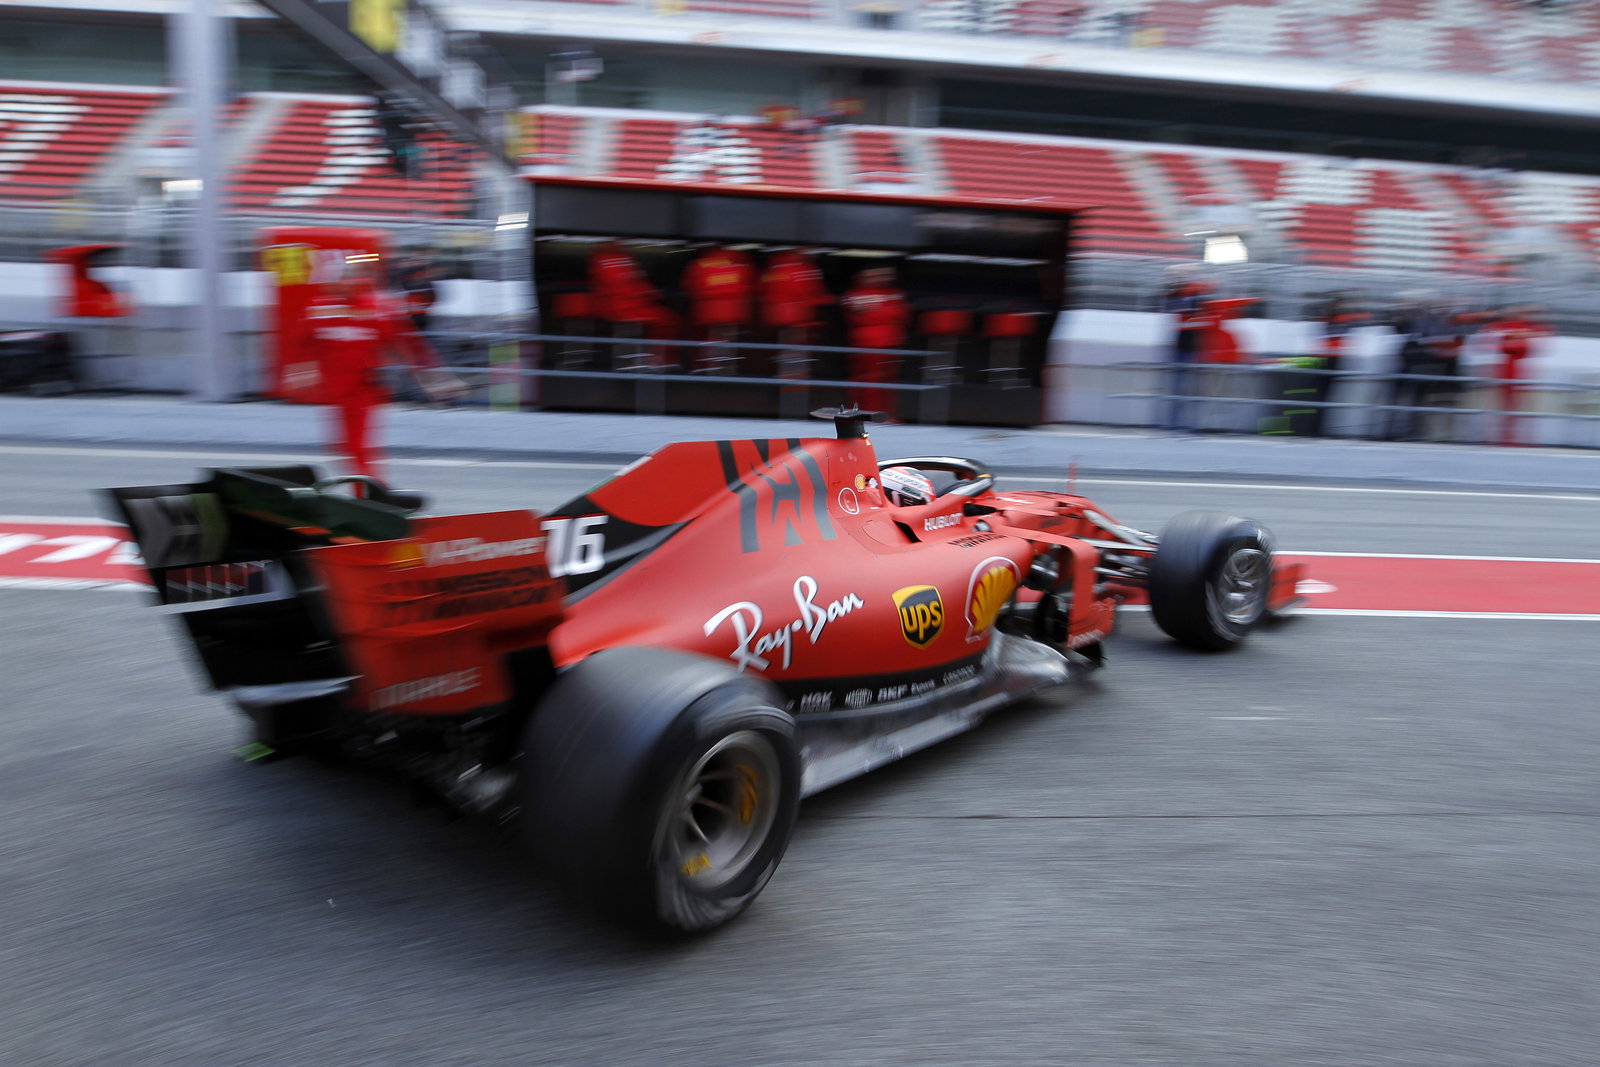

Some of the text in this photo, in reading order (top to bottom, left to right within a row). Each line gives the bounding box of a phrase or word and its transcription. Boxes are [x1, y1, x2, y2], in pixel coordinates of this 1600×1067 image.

[924, 512, 963, 531] HUBLOT
[540, 515, 608, 579] 16
[901, 600, 942, 641] ups
